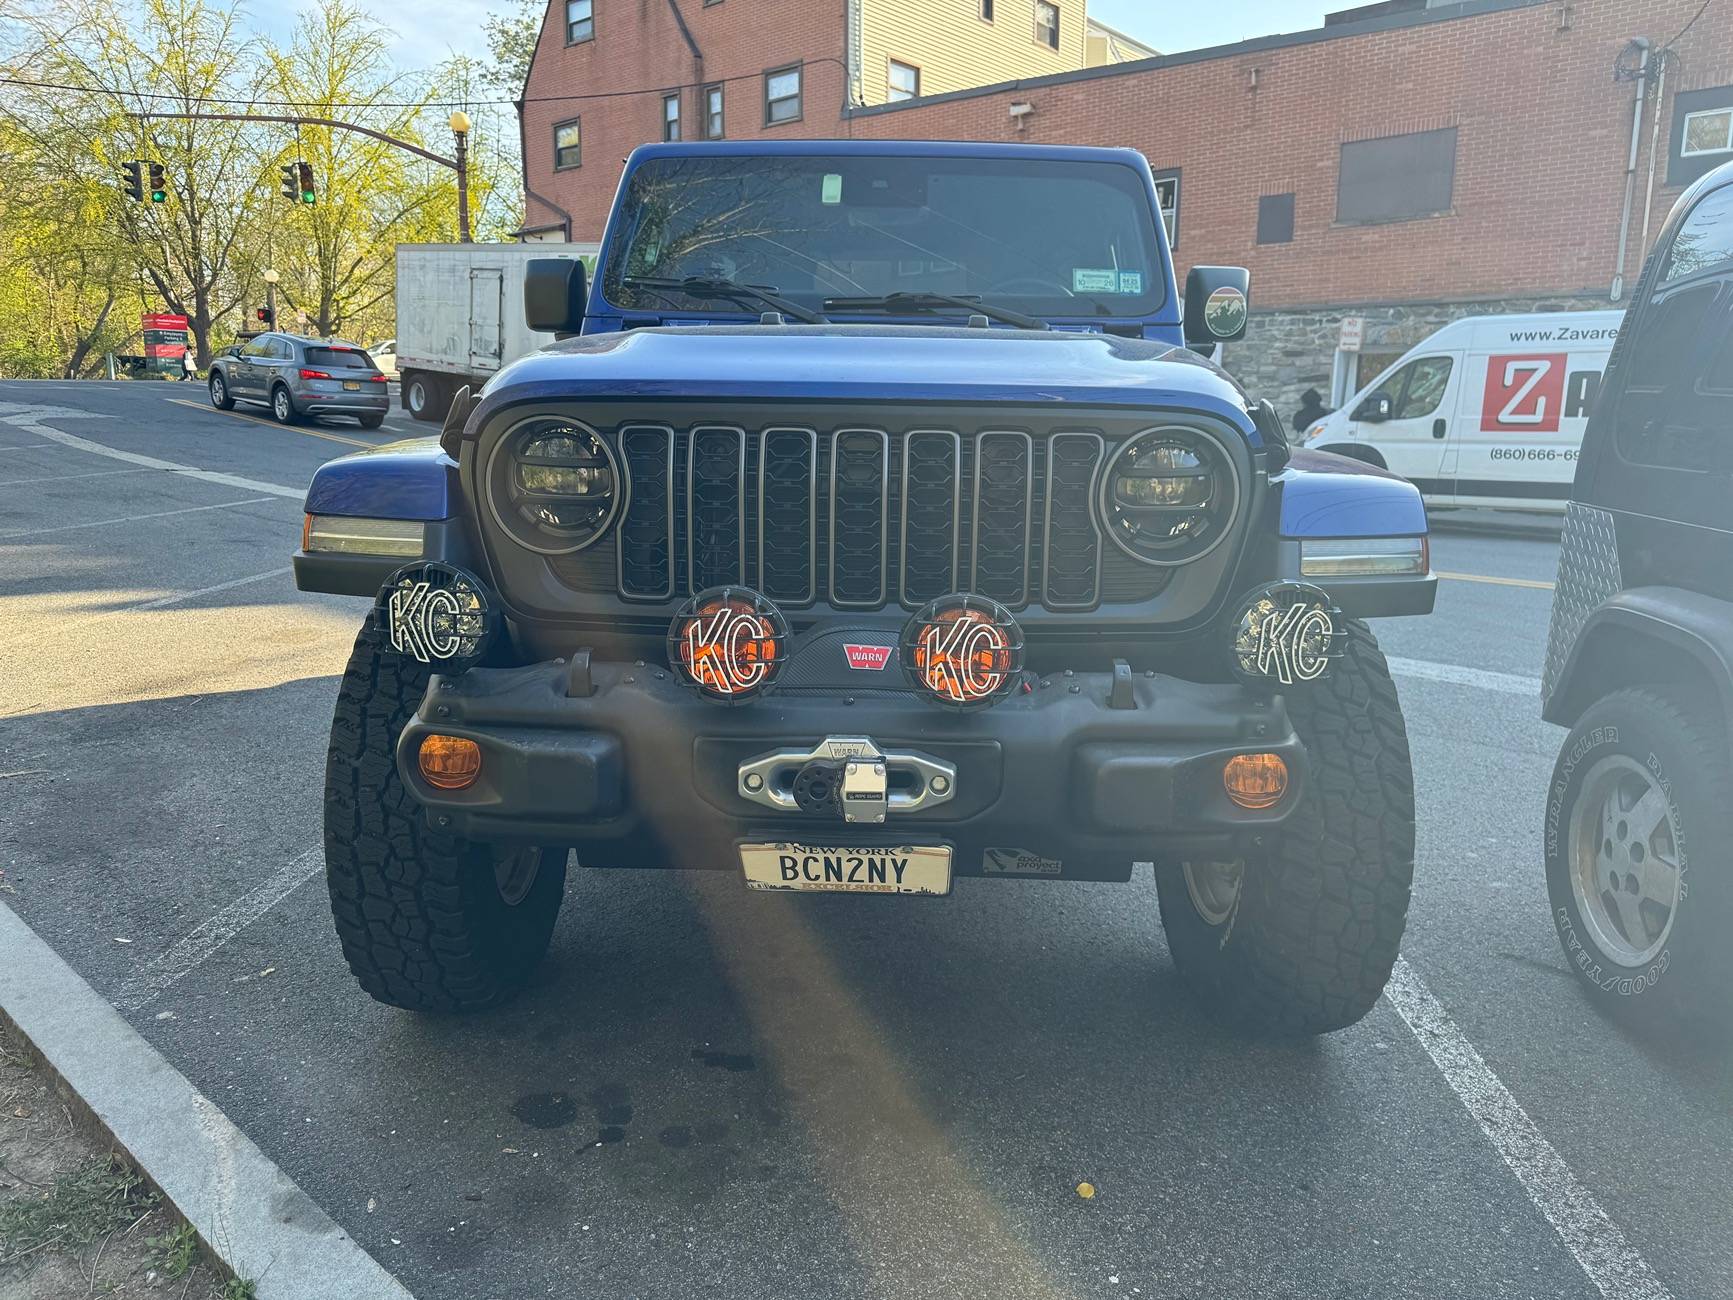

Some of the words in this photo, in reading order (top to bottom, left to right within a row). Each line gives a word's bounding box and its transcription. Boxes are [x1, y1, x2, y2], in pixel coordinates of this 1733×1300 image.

[1510, 328, 1618, 342] www.Zavare
[1490, 448, 1526, 461] (860)
[388, 582, 463, 663] KC
[688, 608, 766, 694] KC
[851, 651, 884, 662] WARN
[924, 616, 1003, 702] KC
[1256, 602, 1334, 685] KC
[1548, 726, 1620, 858] WRANGLER
[779, 855, 909, 884] BCN2NY
[792, 845, 841, 855] NEW
[846, 848, 899, 856] YORK
[1557, 906, 1672, 996] GOODYEAR
